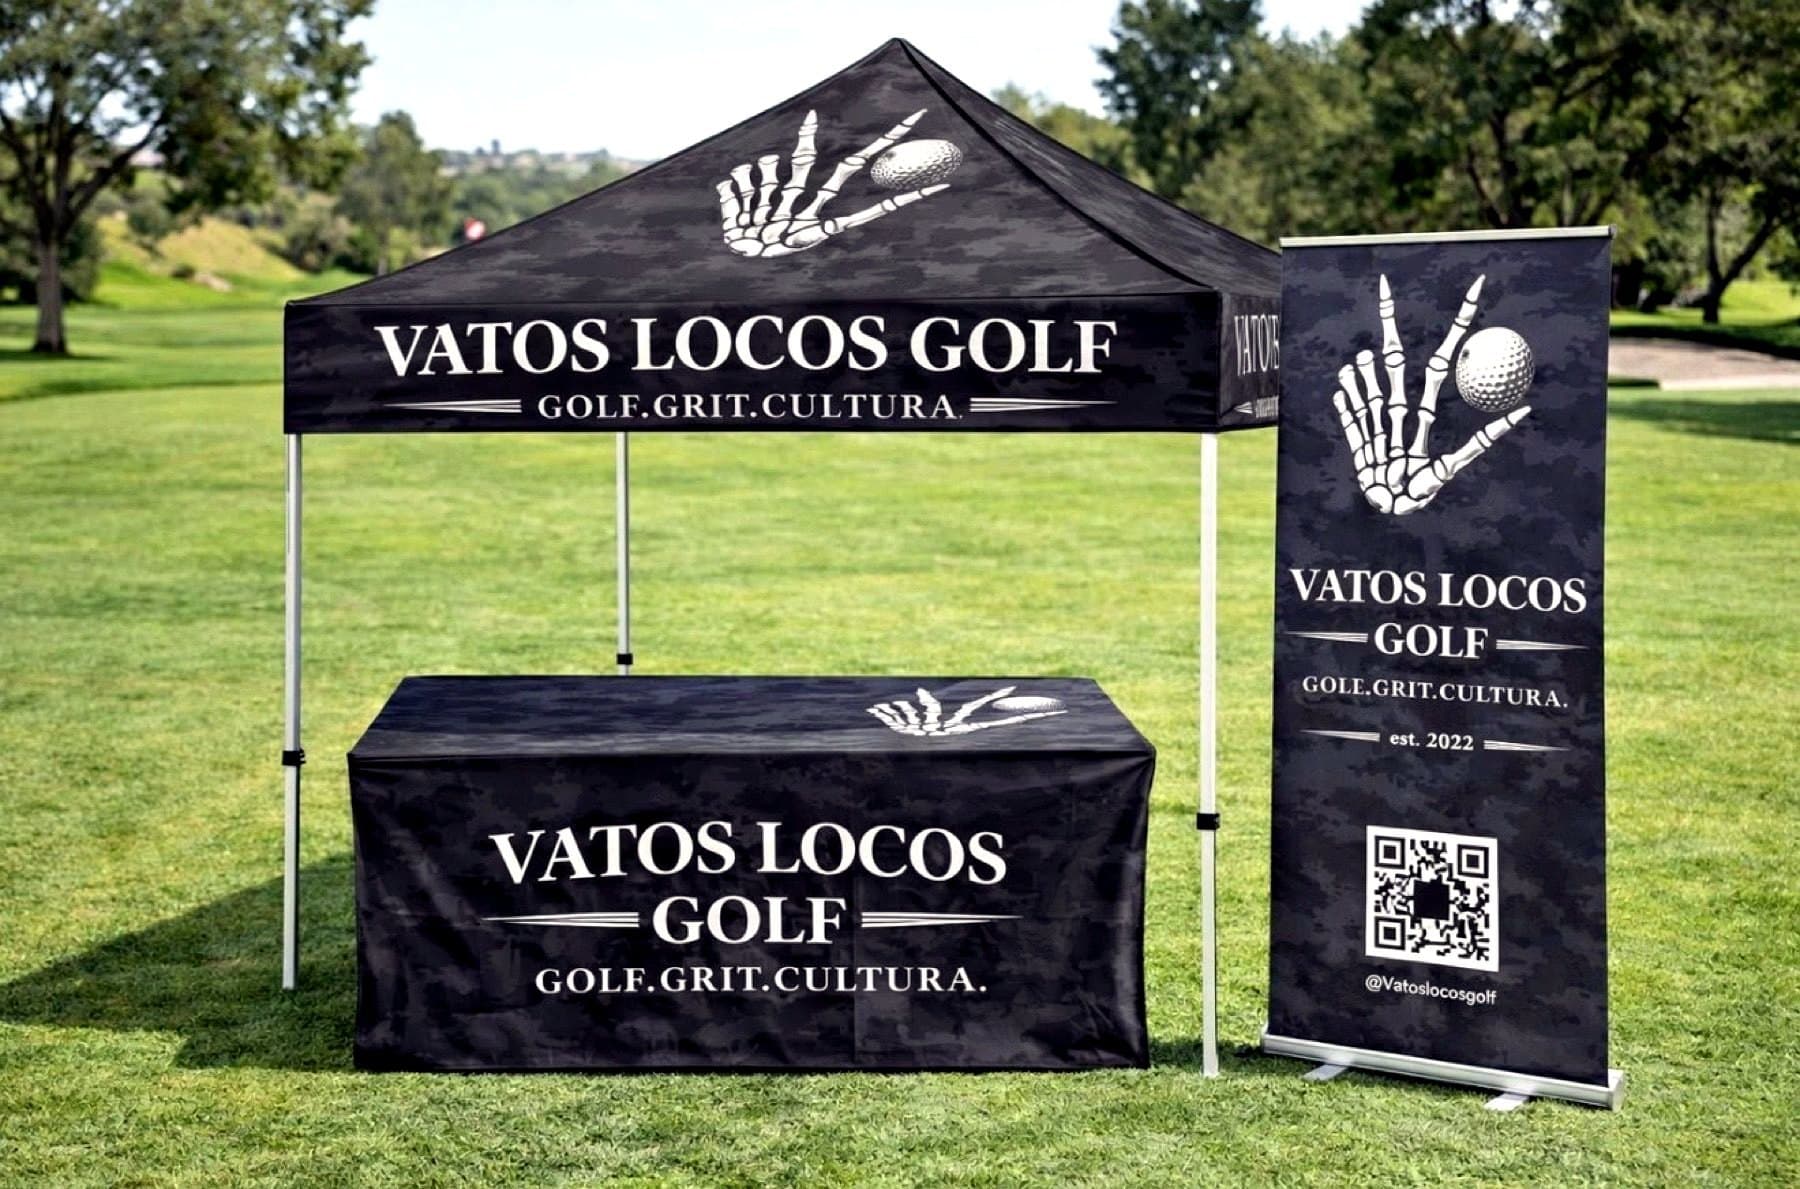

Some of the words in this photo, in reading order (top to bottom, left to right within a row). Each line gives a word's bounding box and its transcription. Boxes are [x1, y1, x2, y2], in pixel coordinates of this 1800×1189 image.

[373, 318, 610, 377] VATOS
[630, 314, 888, 371] LOCOS
[910, 316, 1118, 373] GOLF
[1289, 568, 1427, 606] VATOS
[1438, 572, 1587, 614] LOCOS
[1374, 622, 1489, 660] GOLF
[1389, 733, 1420, 748] est.
[1426, 732, 1475, 751] 2022
[488, 820, 736, 884] VATOS
[757, 821, 1007, 885] LOCOS
[652, 895, 847, 945] GOLF
[535, 966, 988, 994] GOLF.GRIT.CULTURA.
[1364, 974, 1497, 1006] @Vatoslocosgolf
